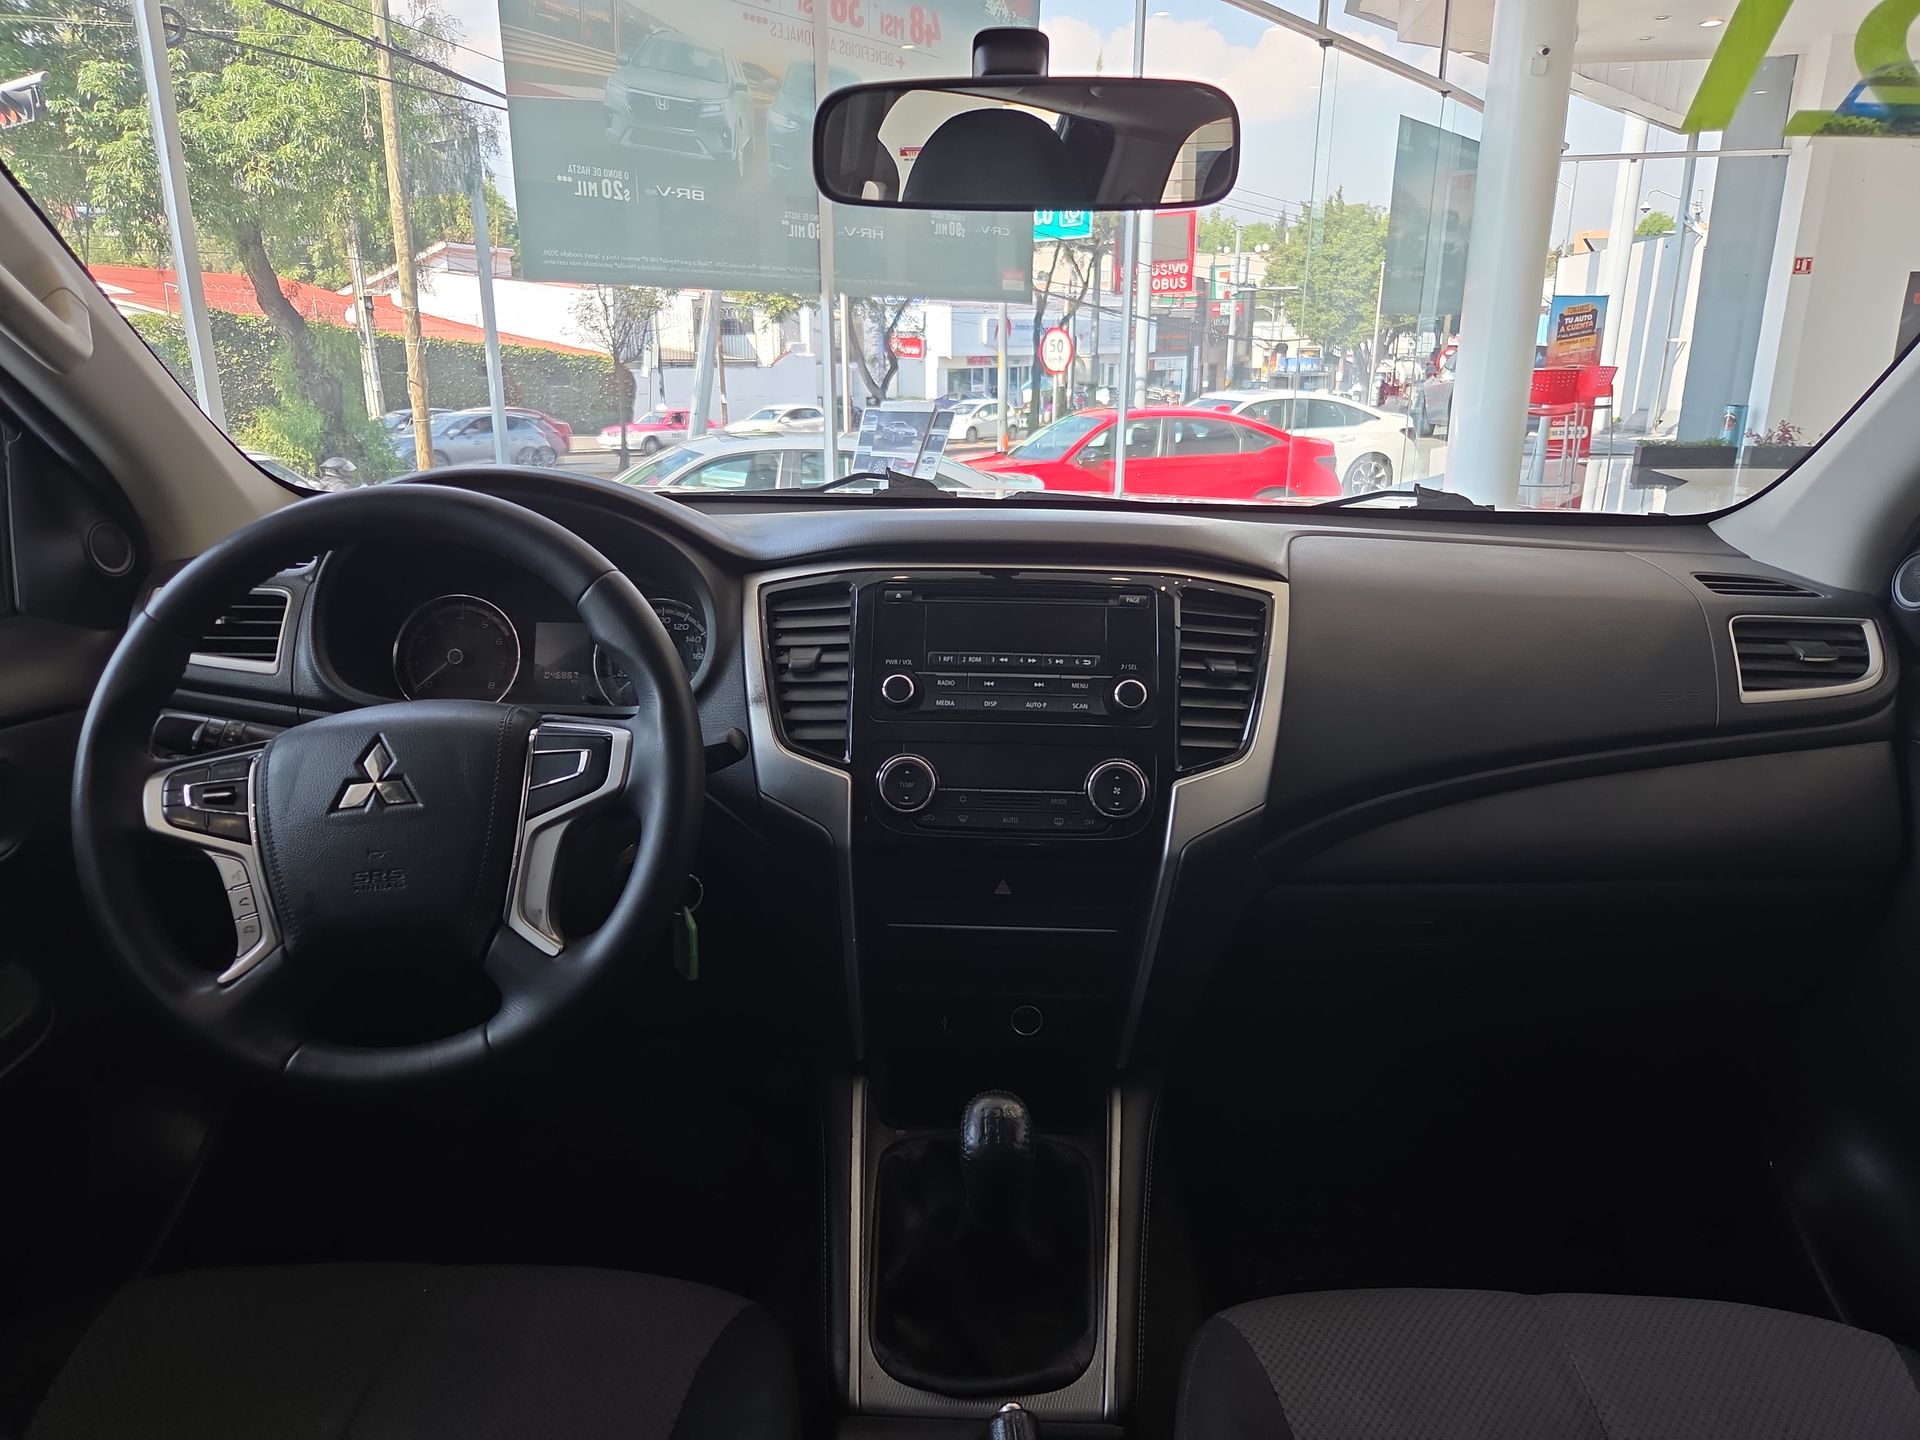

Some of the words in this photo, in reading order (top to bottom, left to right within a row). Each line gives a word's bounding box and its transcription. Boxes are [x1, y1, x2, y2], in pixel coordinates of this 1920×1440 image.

[1564, 316, 1573, 325] TU
[1574, 314, 1593, 323] AUTO
[1566, 321, 1594, 331] CUENTA
[1049, 339, 1064, 353] 50
[673, 623, 690, 631] 120
[487, 681, 496, 689] 8
[353, 868, 408, 884] SRS
